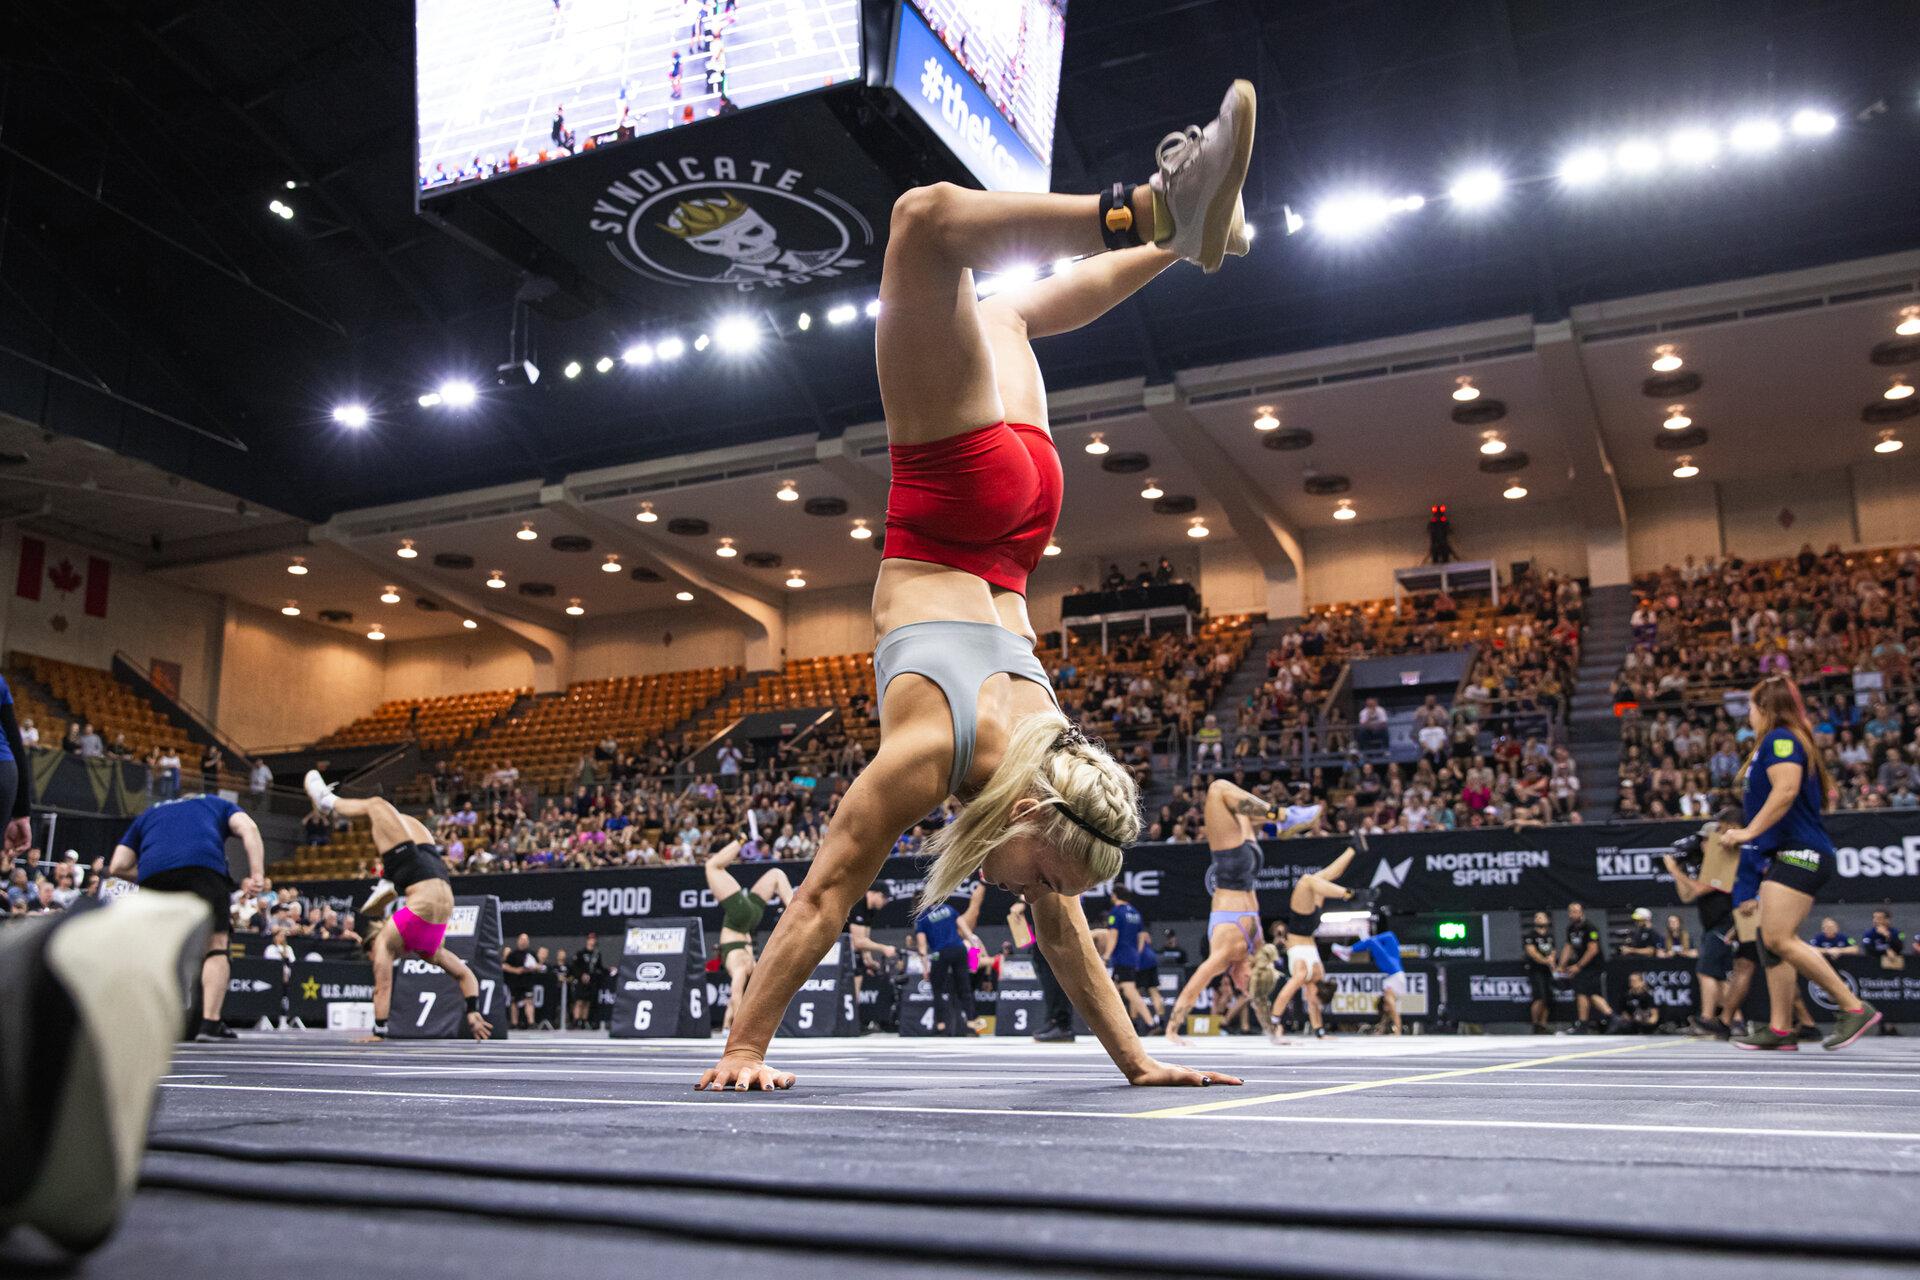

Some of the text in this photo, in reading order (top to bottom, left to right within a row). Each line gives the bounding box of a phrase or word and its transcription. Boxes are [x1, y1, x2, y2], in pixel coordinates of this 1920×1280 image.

[589, 156, 803, 234] SYNDICATE
[1426, 851, 1549, 871] NORTHERN
[1453, 868, 1522, 886] SPIRIT
[581, 887, 651, 917] 2POOD
[480, 980, 496, 1015] 7
[690, 988, 703, 1019] 6
[843, 994, 855, 1021] 5
[1000, 989, 1044, 1001] ROGUE
[415, 992, 437, 1027] 7
[634, 1000, 653, 1031] 6
[798, 1002, 815, 1029] 5
[920, 1006, 935, 1031] 4
[1013, 1008, 1029, 1031] 3
